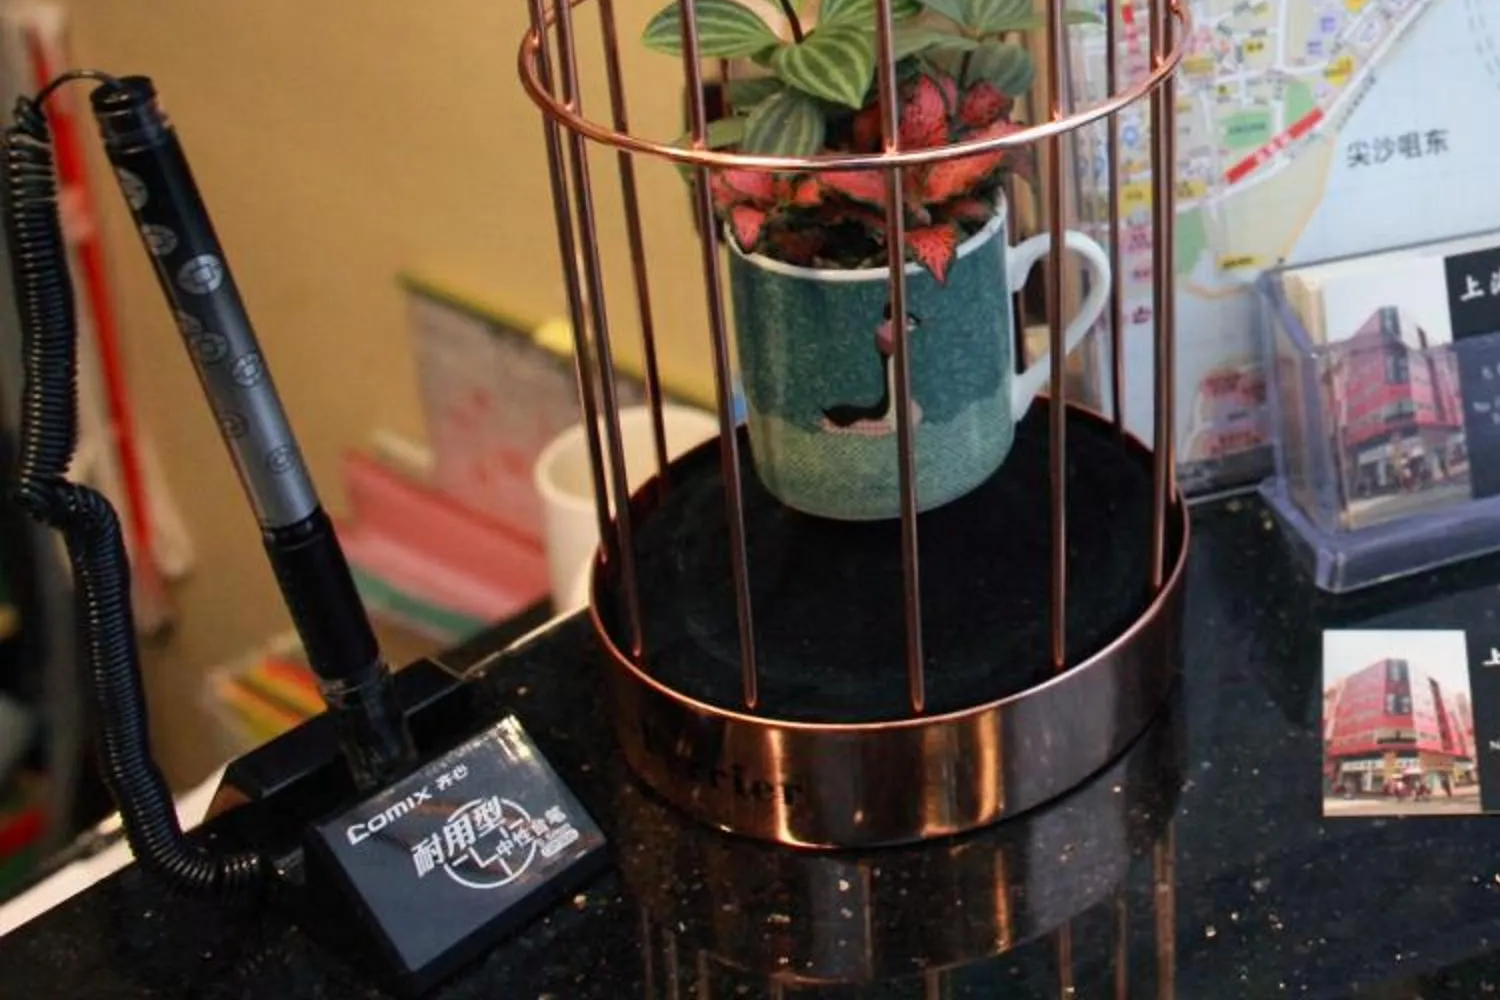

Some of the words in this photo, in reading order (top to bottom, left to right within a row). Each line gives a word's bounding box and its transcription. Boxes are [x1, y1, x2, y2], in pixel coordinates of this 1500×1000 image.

[1347, 129, 1449, 168] 尖沙咀东
[410, 795, 506, 879] 耐用型
